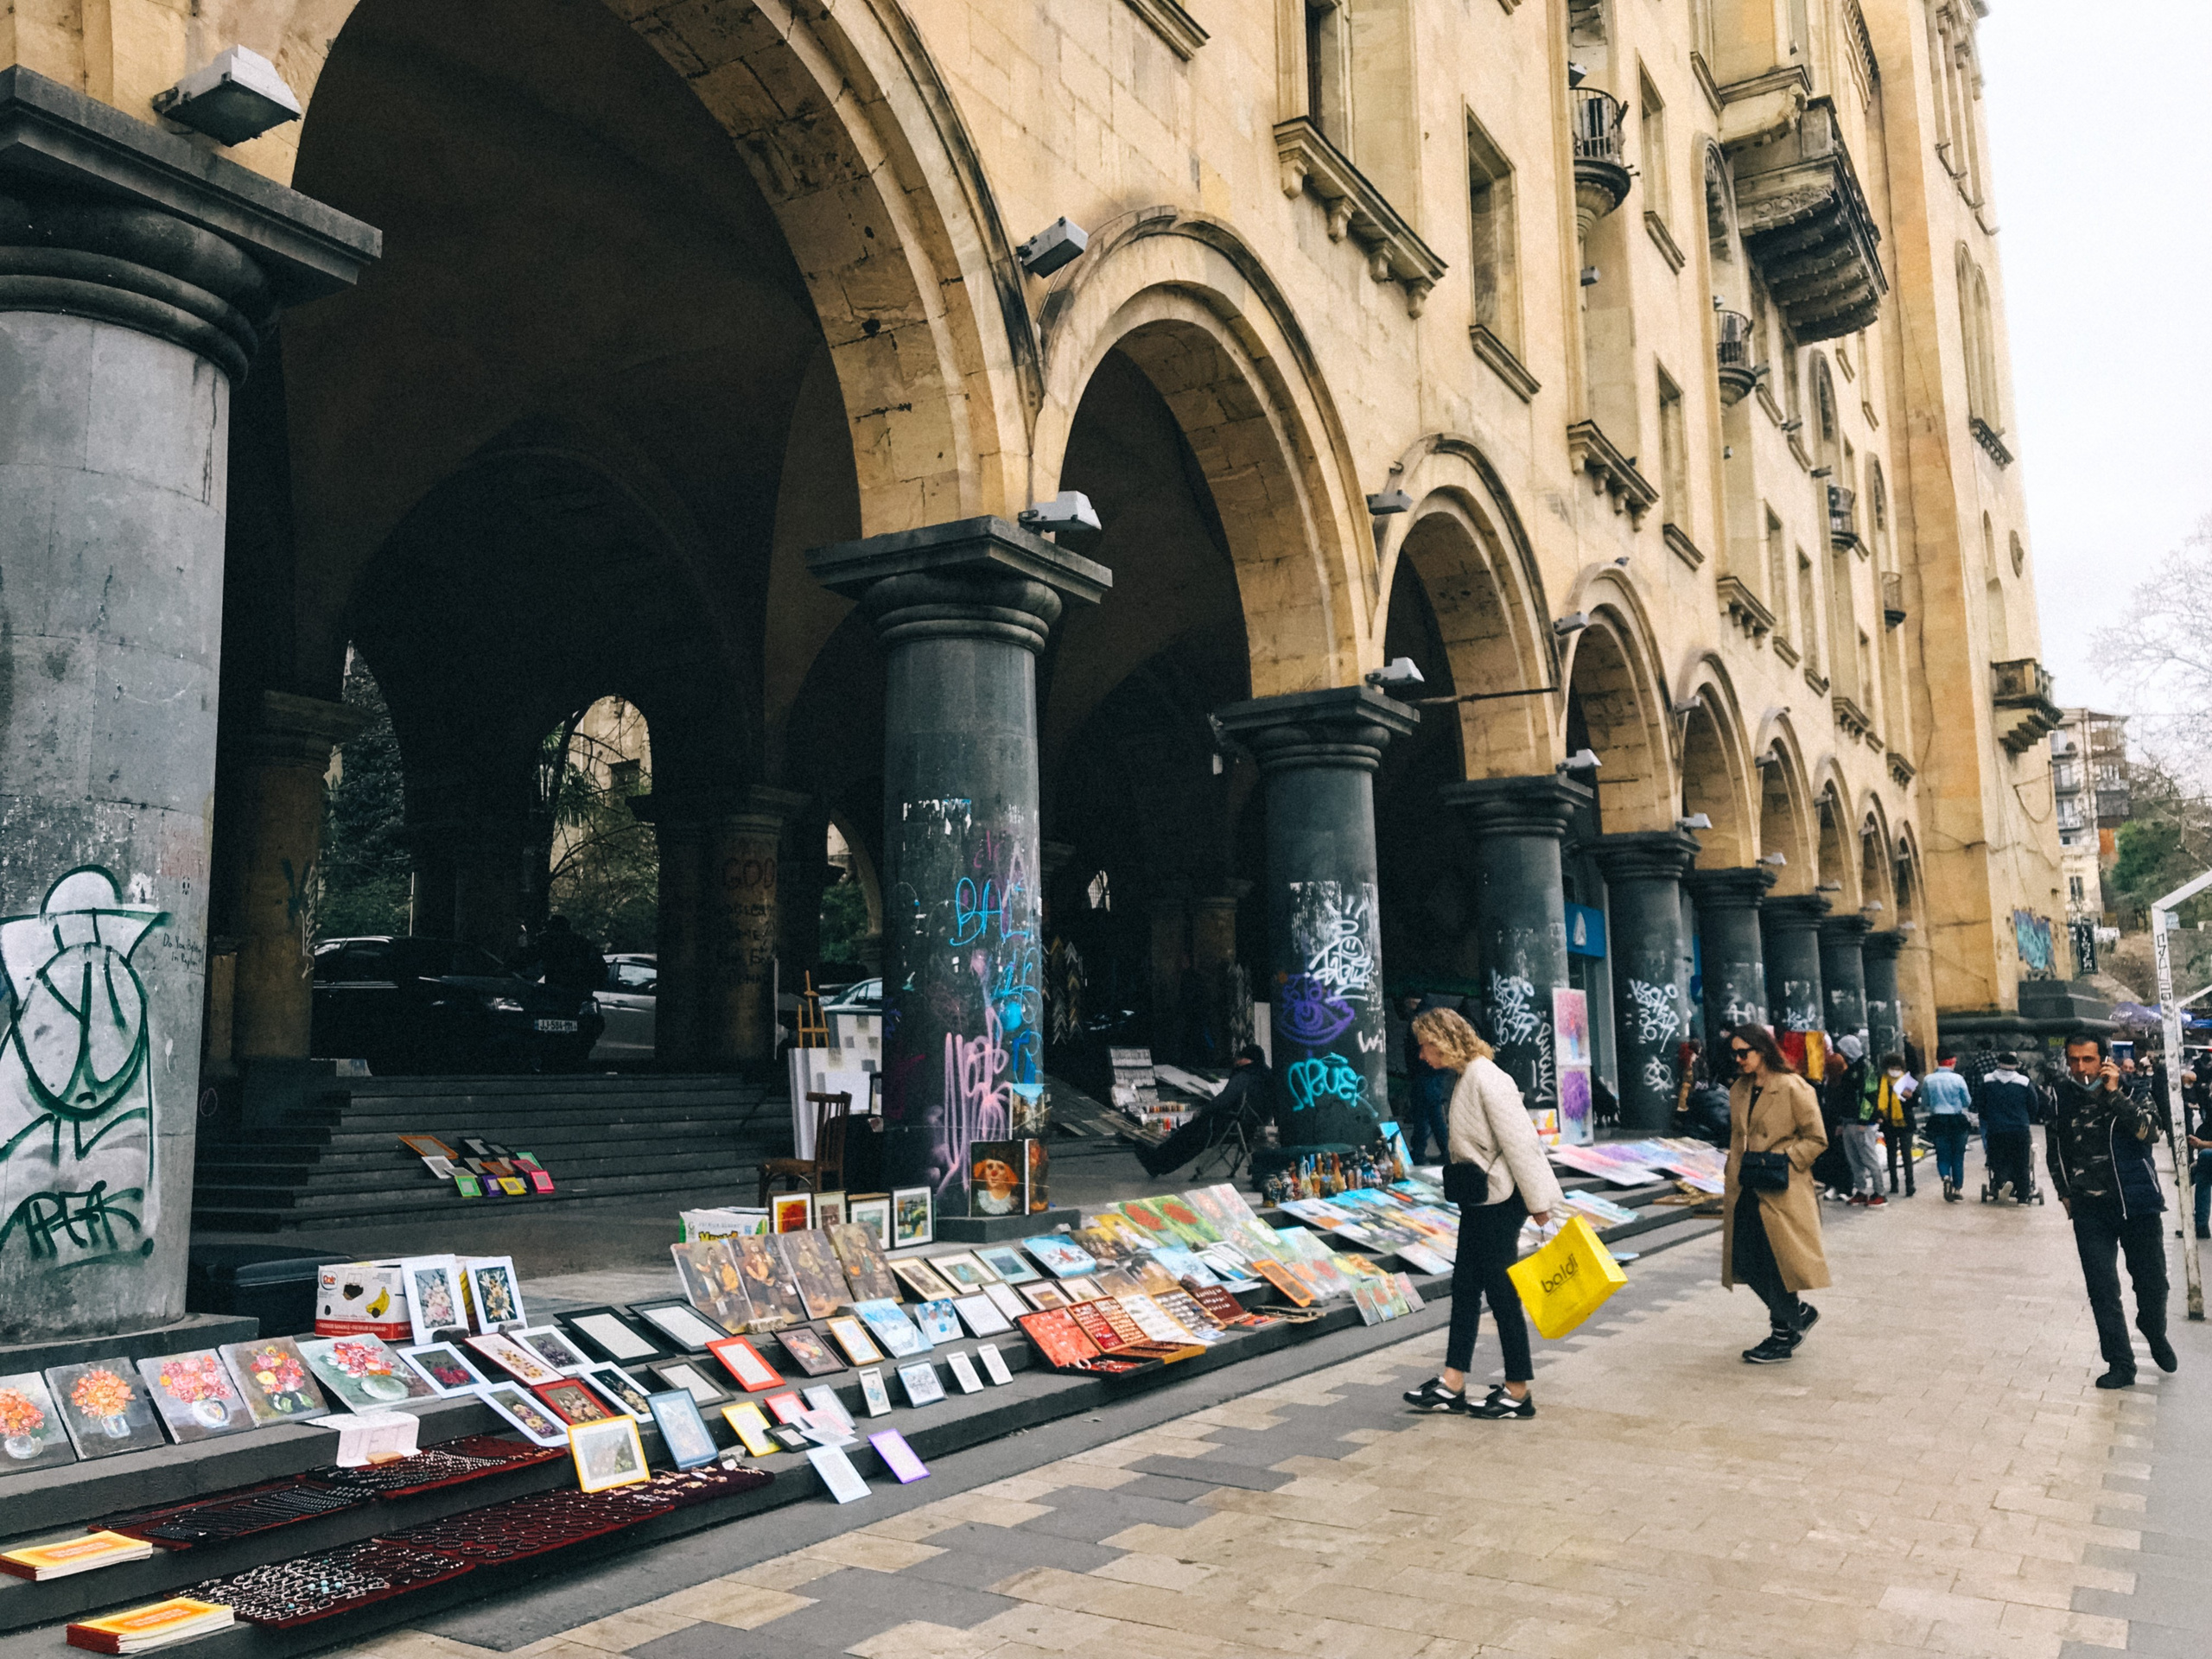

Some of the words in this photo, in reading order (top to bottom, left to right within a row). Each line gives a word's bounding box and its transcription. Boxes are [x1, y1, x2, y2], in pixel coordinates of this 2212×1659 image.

[163, 932, 173, 948] Do
[1541, 1253, 1579, 1294] baldi
[346, 1423, 408, 1459] JET
